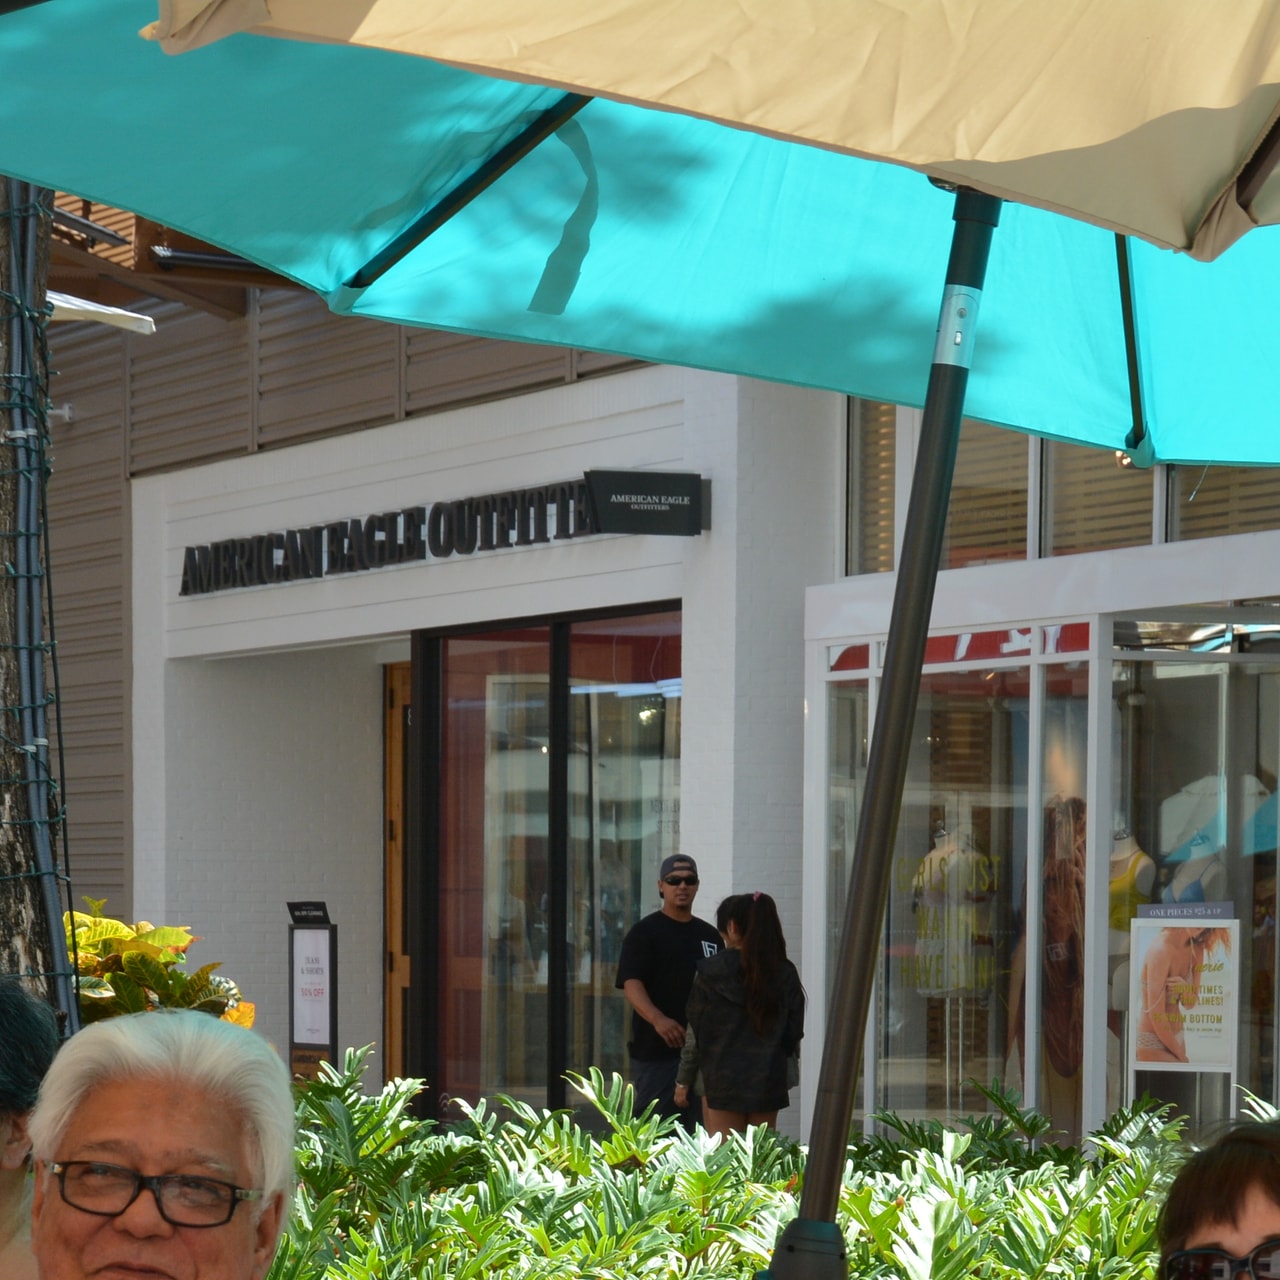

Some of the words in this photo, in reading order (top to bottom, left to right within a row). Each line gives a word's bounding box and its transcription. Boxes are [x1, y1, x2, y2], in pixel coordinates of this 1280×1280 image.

[610, 494, 659, 504] AMERICAN
[661, 496, 690, 505] EAGLE
[630, 503, 670, 511] OUTFITTERS
[180, 527, 323, 596] AMERICAN
[324, 506, 426, 575] EAGLE
[896, 856, 949, 892] GIRLS
[1167, 908, 1193, 916] PIECES
[899, 953, 944, 990] HAVE
[1194, 960, 1225, 974] aerie
[1199, 985, 1224, 995] TIMES
[1197, 996, 1224, 1006] LINES!
[1190, 1013, 1223, 1024] BOTTOM
